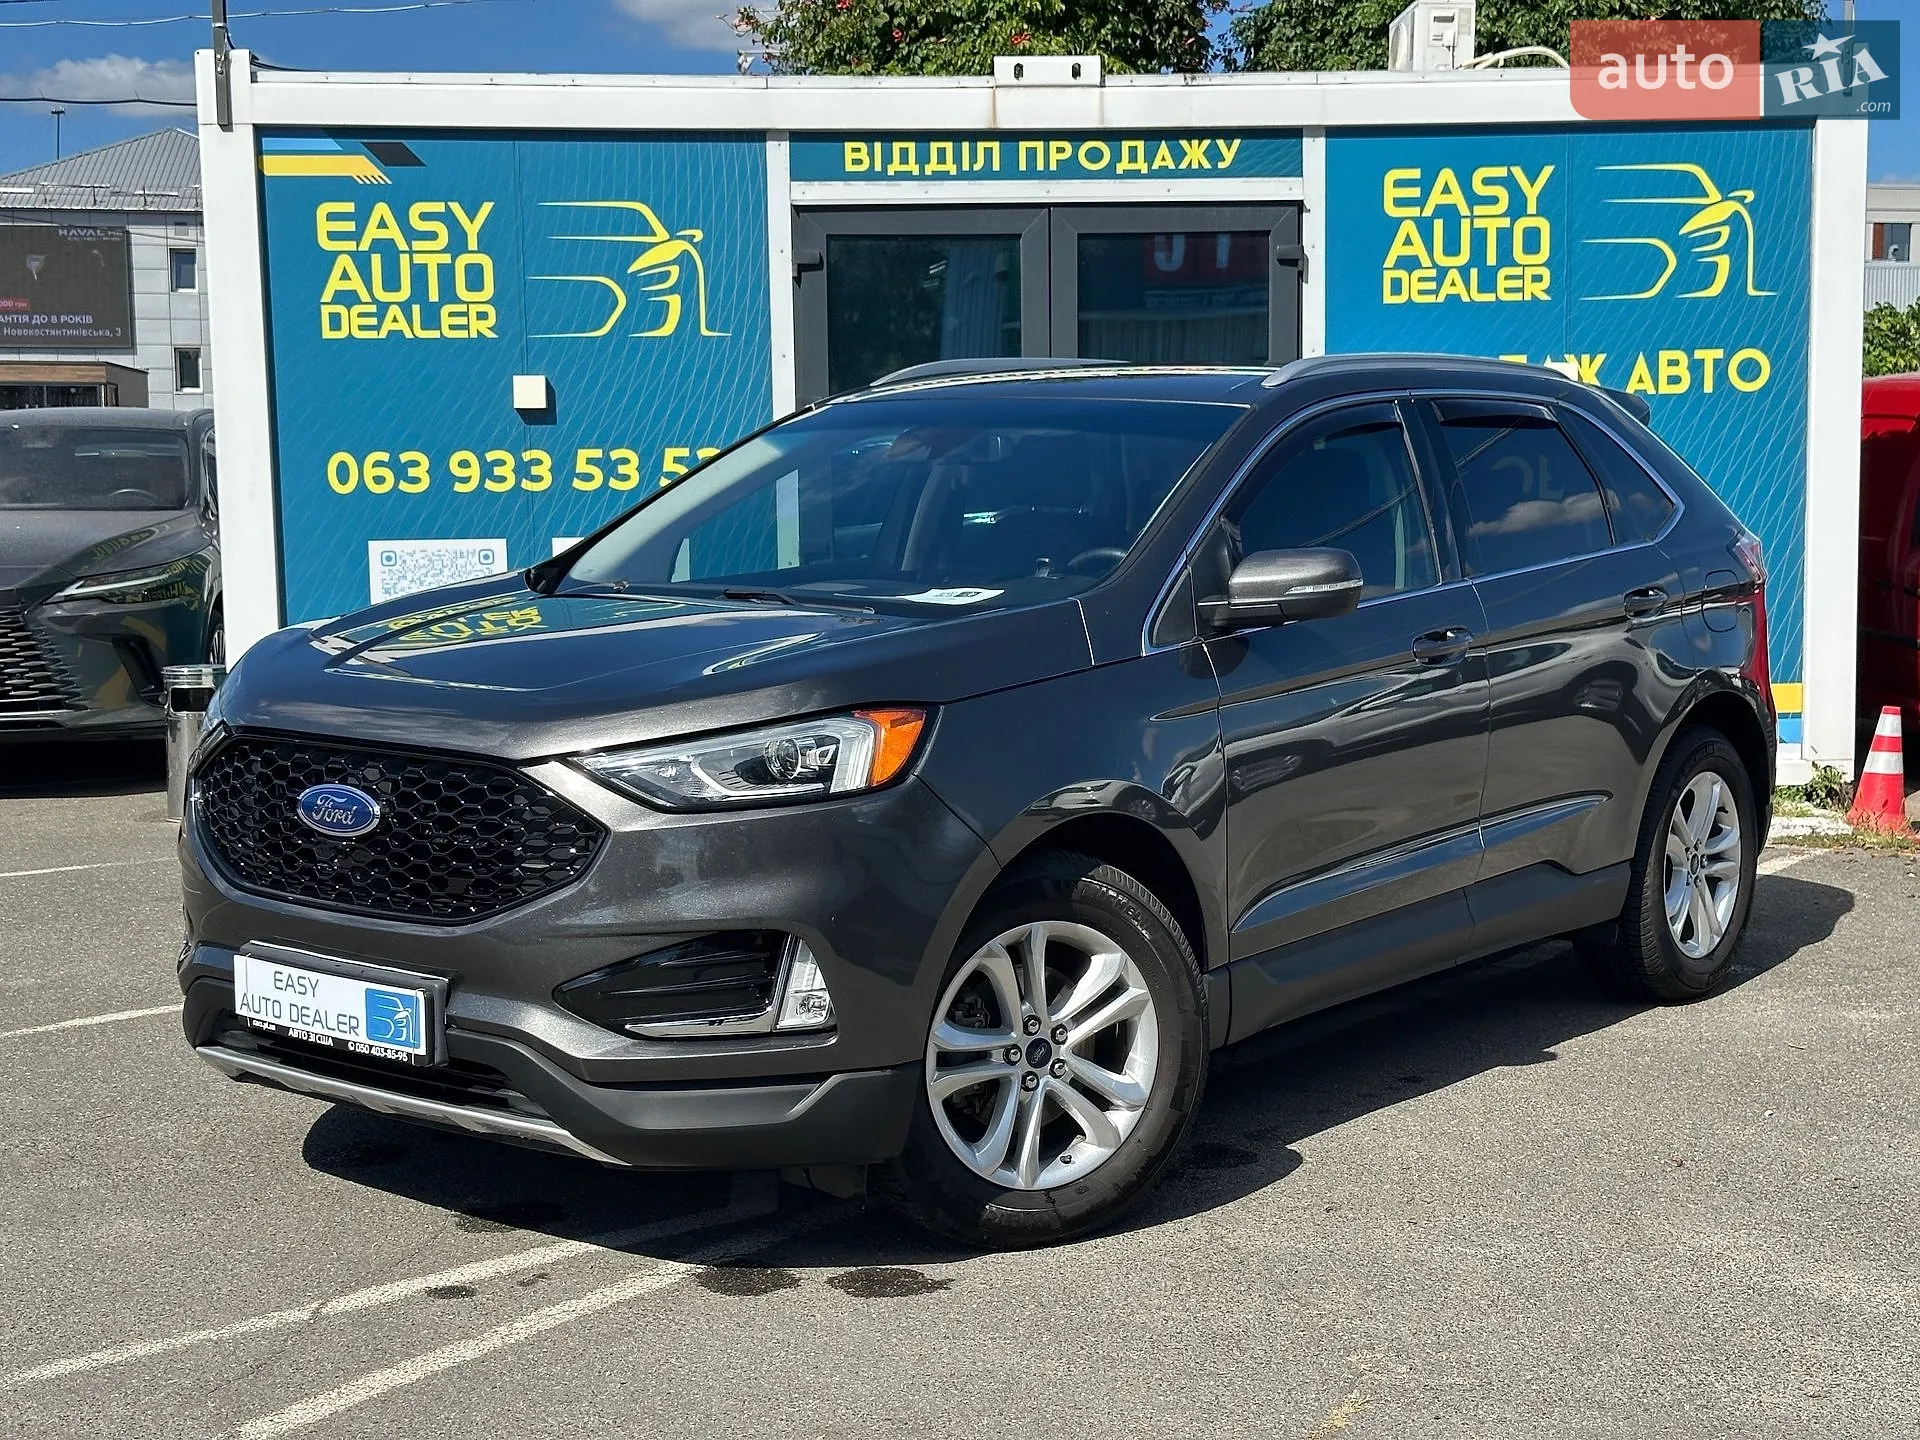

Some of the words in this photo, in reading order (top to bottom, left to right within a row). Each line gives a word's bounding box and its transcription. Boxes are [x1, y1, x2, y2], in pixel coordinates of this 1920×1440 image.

[843, 141, 1000, 176] ВІДДІЛ
[1018, 138, 1242, 174] ПРОДАЖУ
[1383, 165, 1556, 217] EASY
[316, 201, 495, 251] EASY
[1383, 216, 1550, 268] AUTO
[320, 253, 495, 303] AUTO
[1382, 266, 1551, 304] DEALER
[32, 315, 48, 325] ДО
[60, 315, 93, 324] РОКІВ
[320, 304, 499, 339] DEALER
[1625, 348, 1771, 395] АВТО
[327, 451, 430, 494] 063
[449, 450, 553, 492] 933
[572, 448, 640, 491] 53
[312, 794, 357, 825] Ford
[273, 971, 319, 998] EASY
[239, 992, 282, 1020] AUTO
[289, 1003, 360, 1036] DEALER
